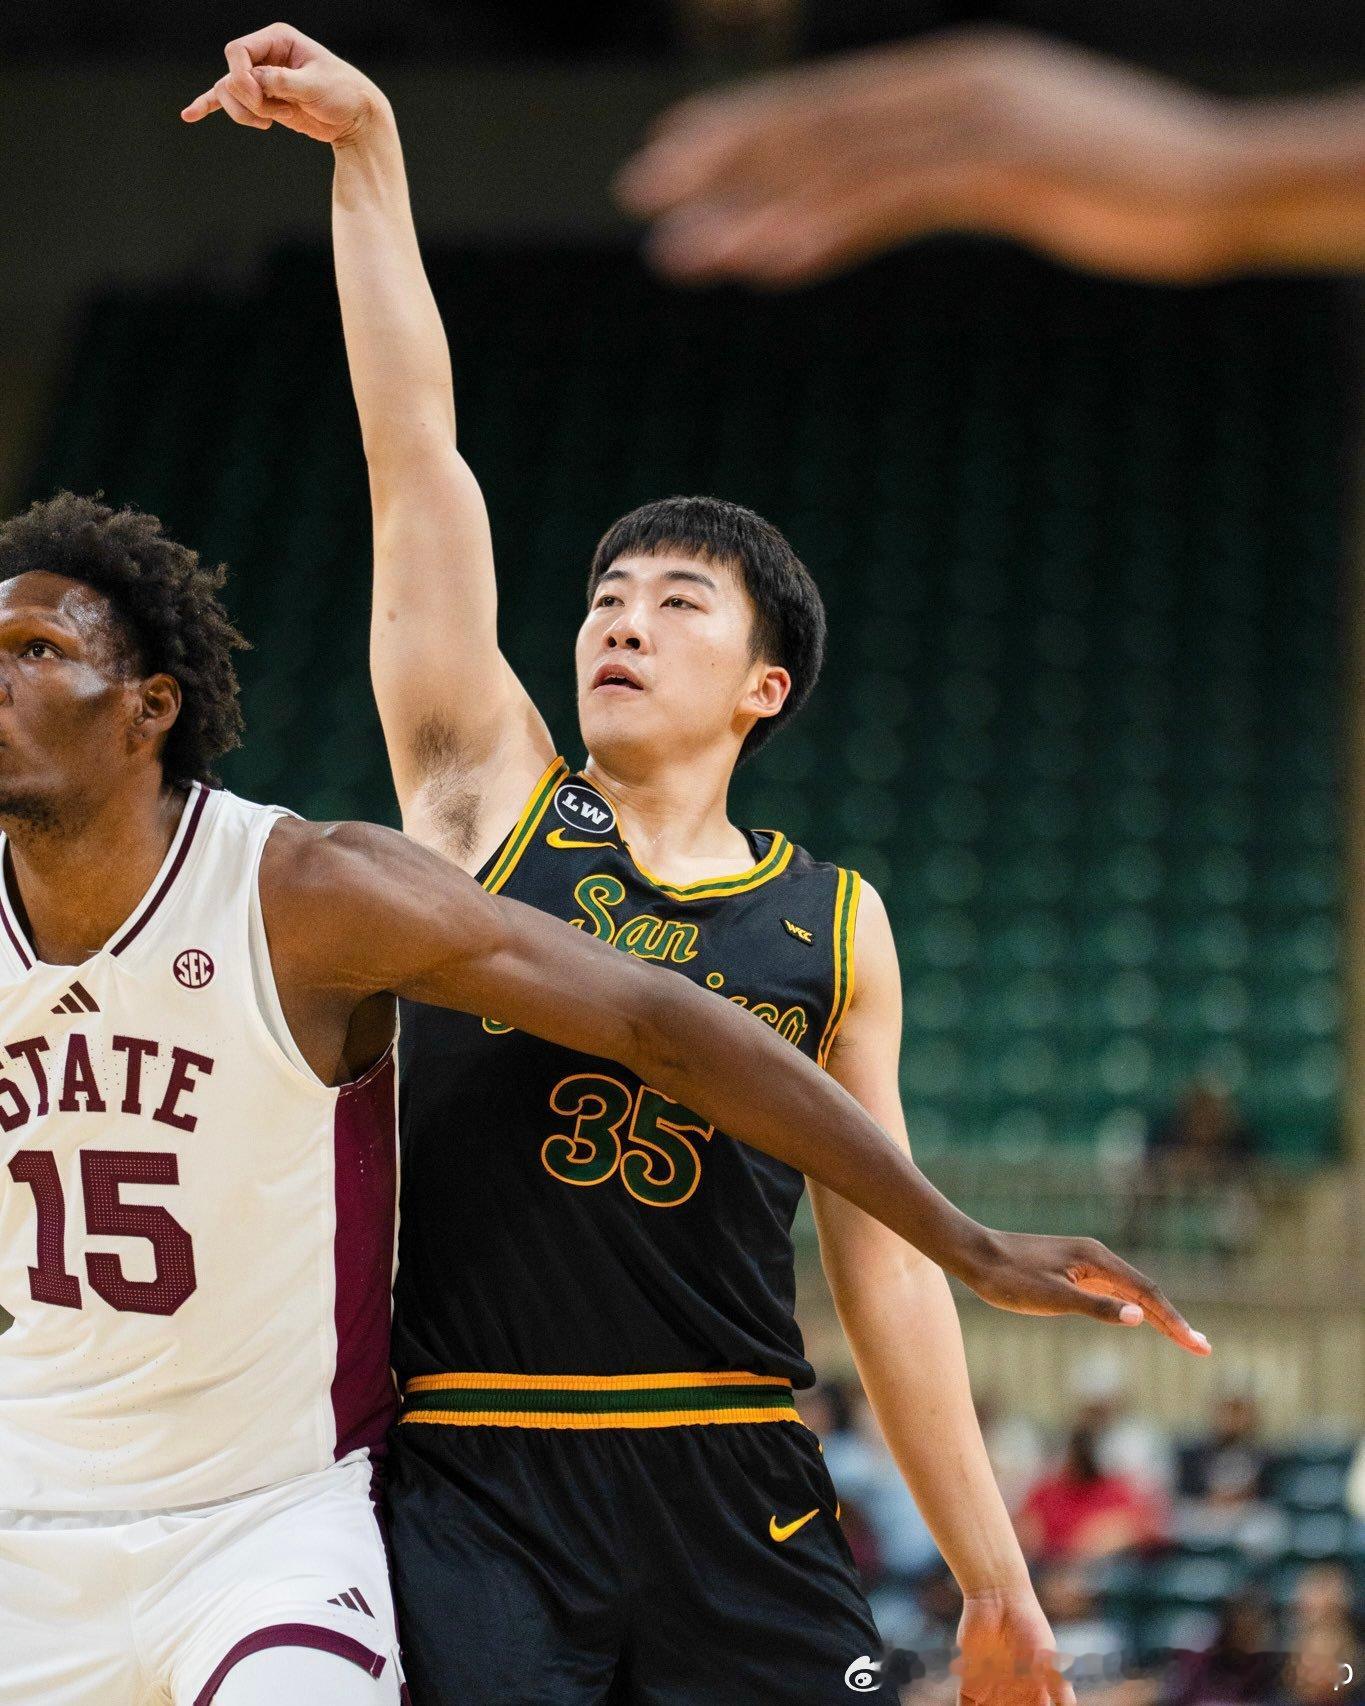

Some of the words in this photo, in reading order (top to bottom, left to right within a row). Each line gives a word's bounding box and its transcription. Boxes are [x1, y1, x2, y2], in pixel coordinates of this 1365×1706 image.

[562, 791, 609, 825] LW
[567, 873, 699, 963] San
[175, 951, 212, 987] SEC
[541, 1073, 715, 1208] 35
[7, 1149, 198, 1316] 15
